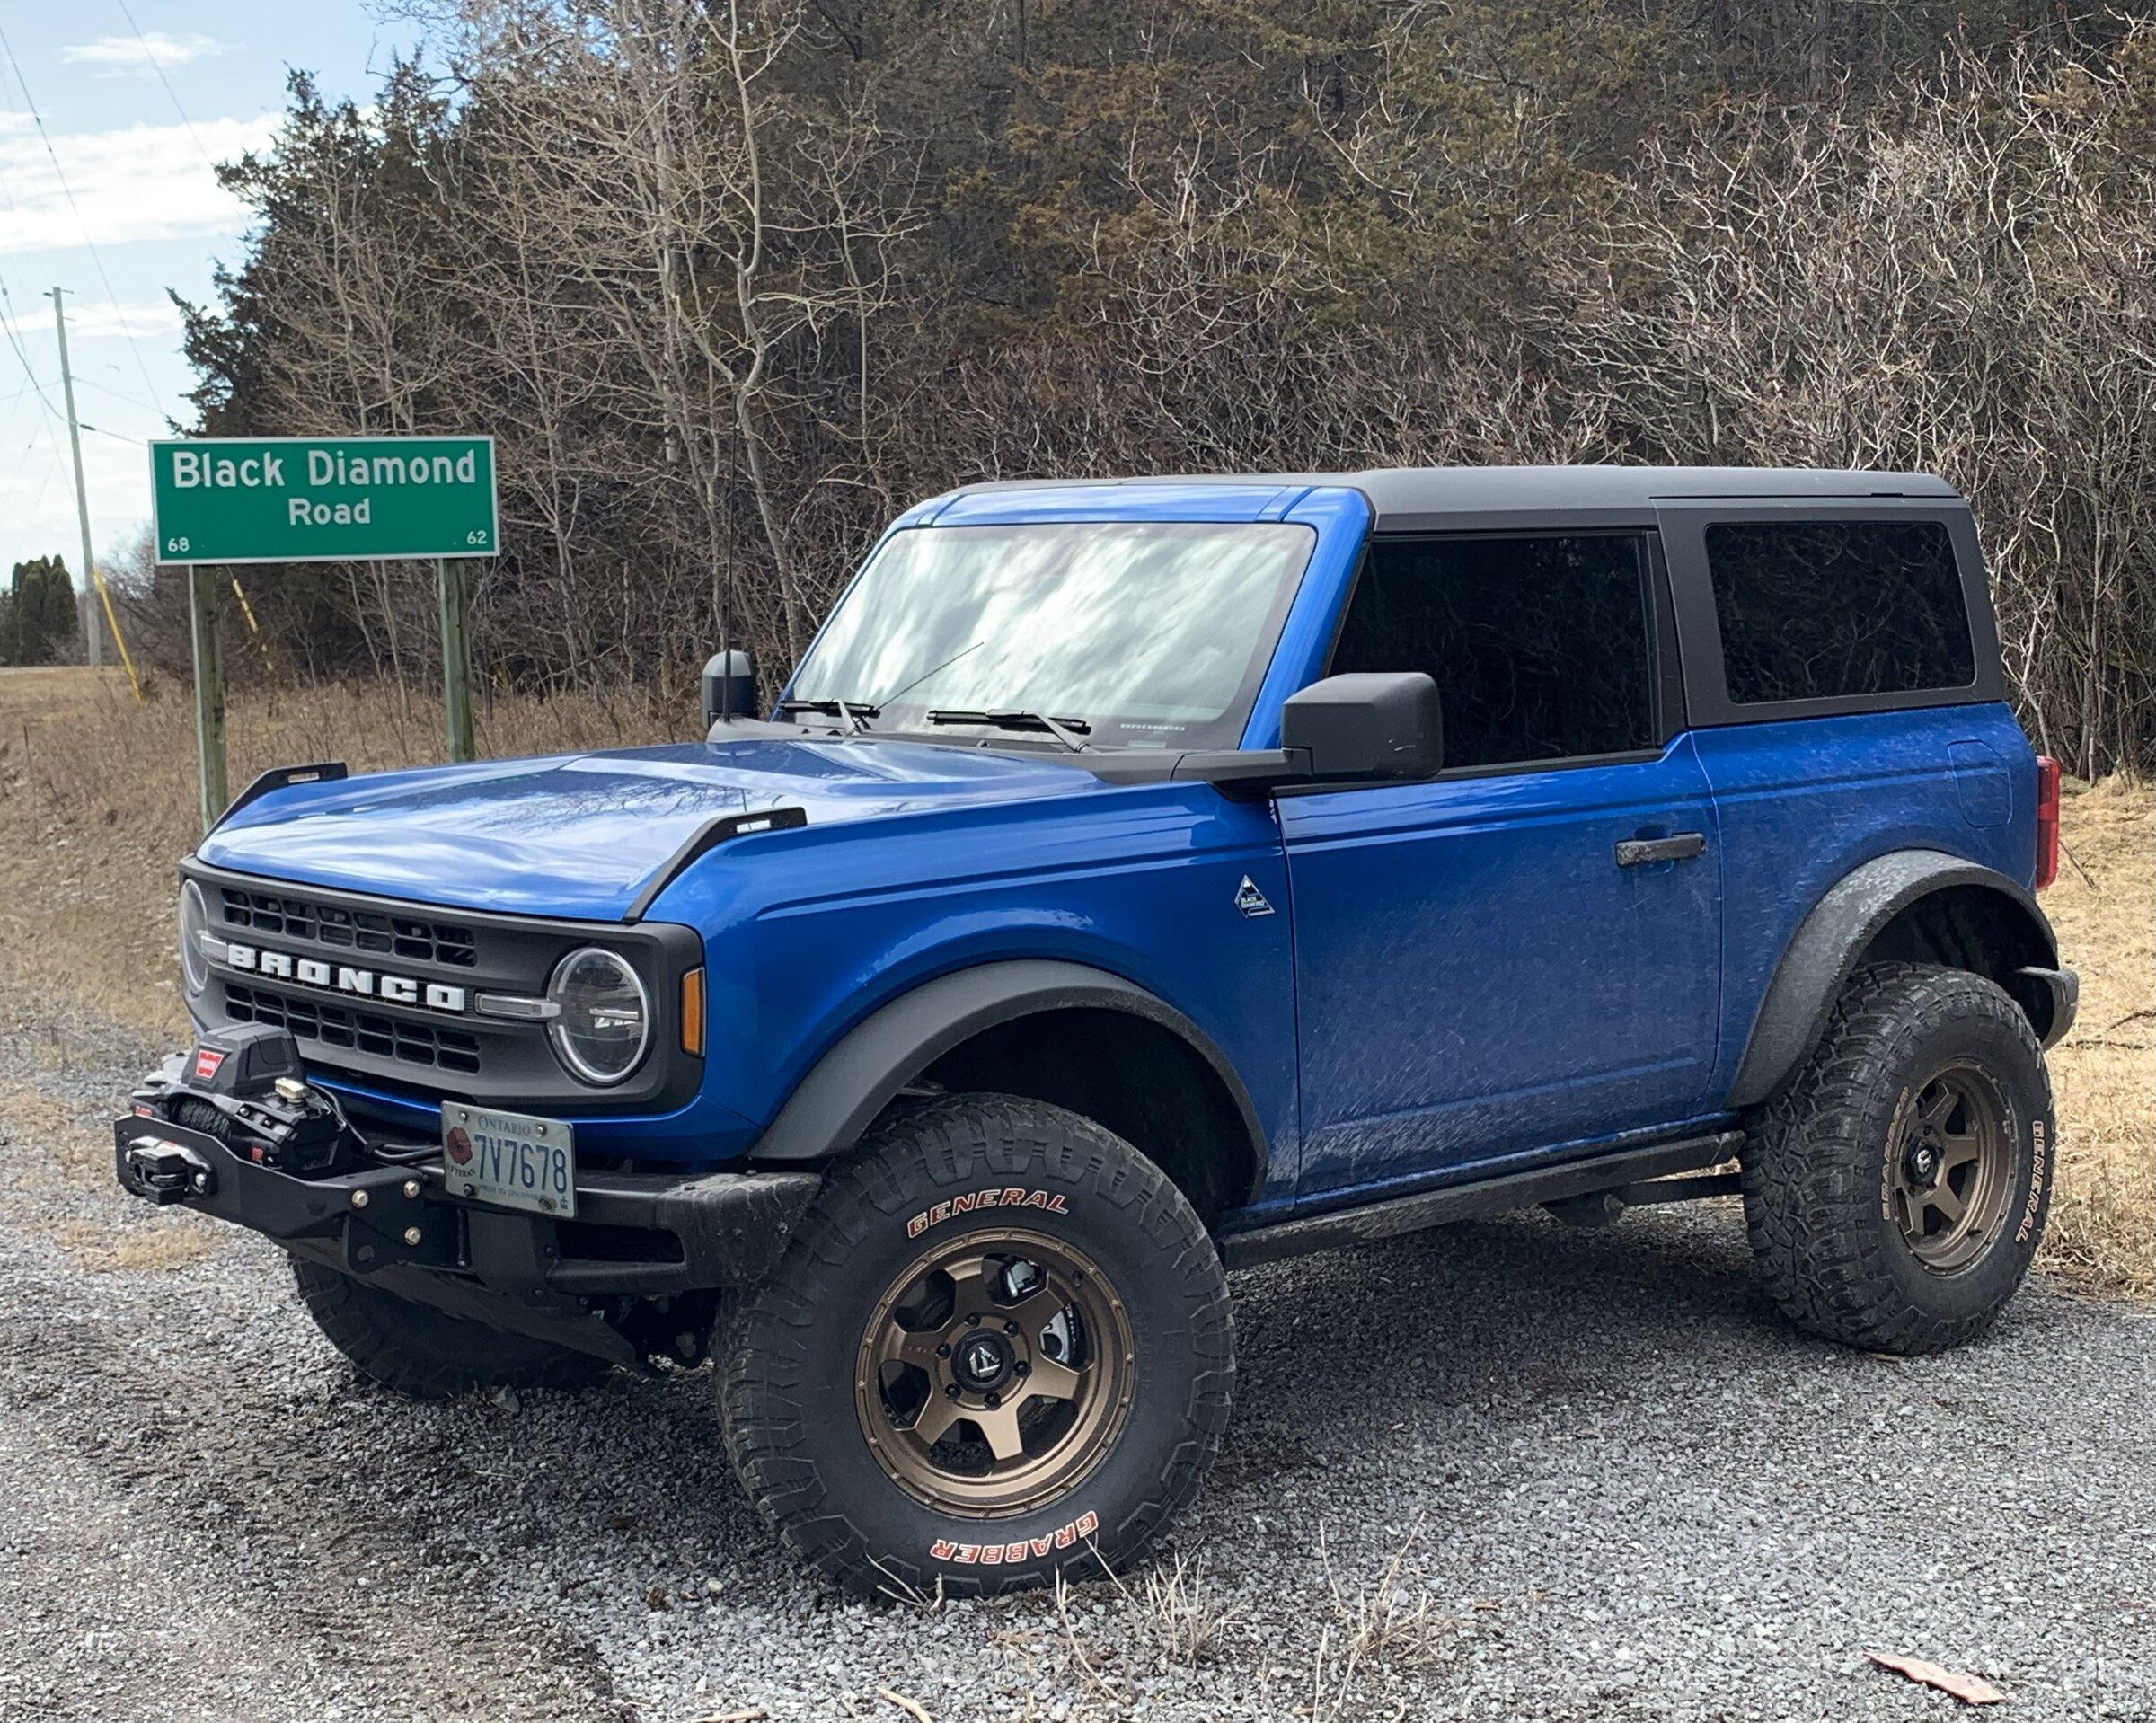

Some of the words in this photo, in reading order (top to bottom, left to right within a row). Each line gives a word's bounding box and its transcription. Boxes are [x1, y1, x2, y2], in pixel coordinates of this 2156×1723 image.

[172, 450, 285, 489] Black
[308, 448, 476, 487] Diamond
[288, 497, 371, 526] Road
[167, 537, 190, 553] 68
[466, 530, 488, 546] 62
[227, 943, 465, 1012] BRONCO
[474, 1133, 568, 1195] 7V7678
[2014, 1119, 2046, 1243] GENERAL
[906, 1188, 1070, 1239] GENERAL
[929, 1509, 1100, 1565] GRABBER
